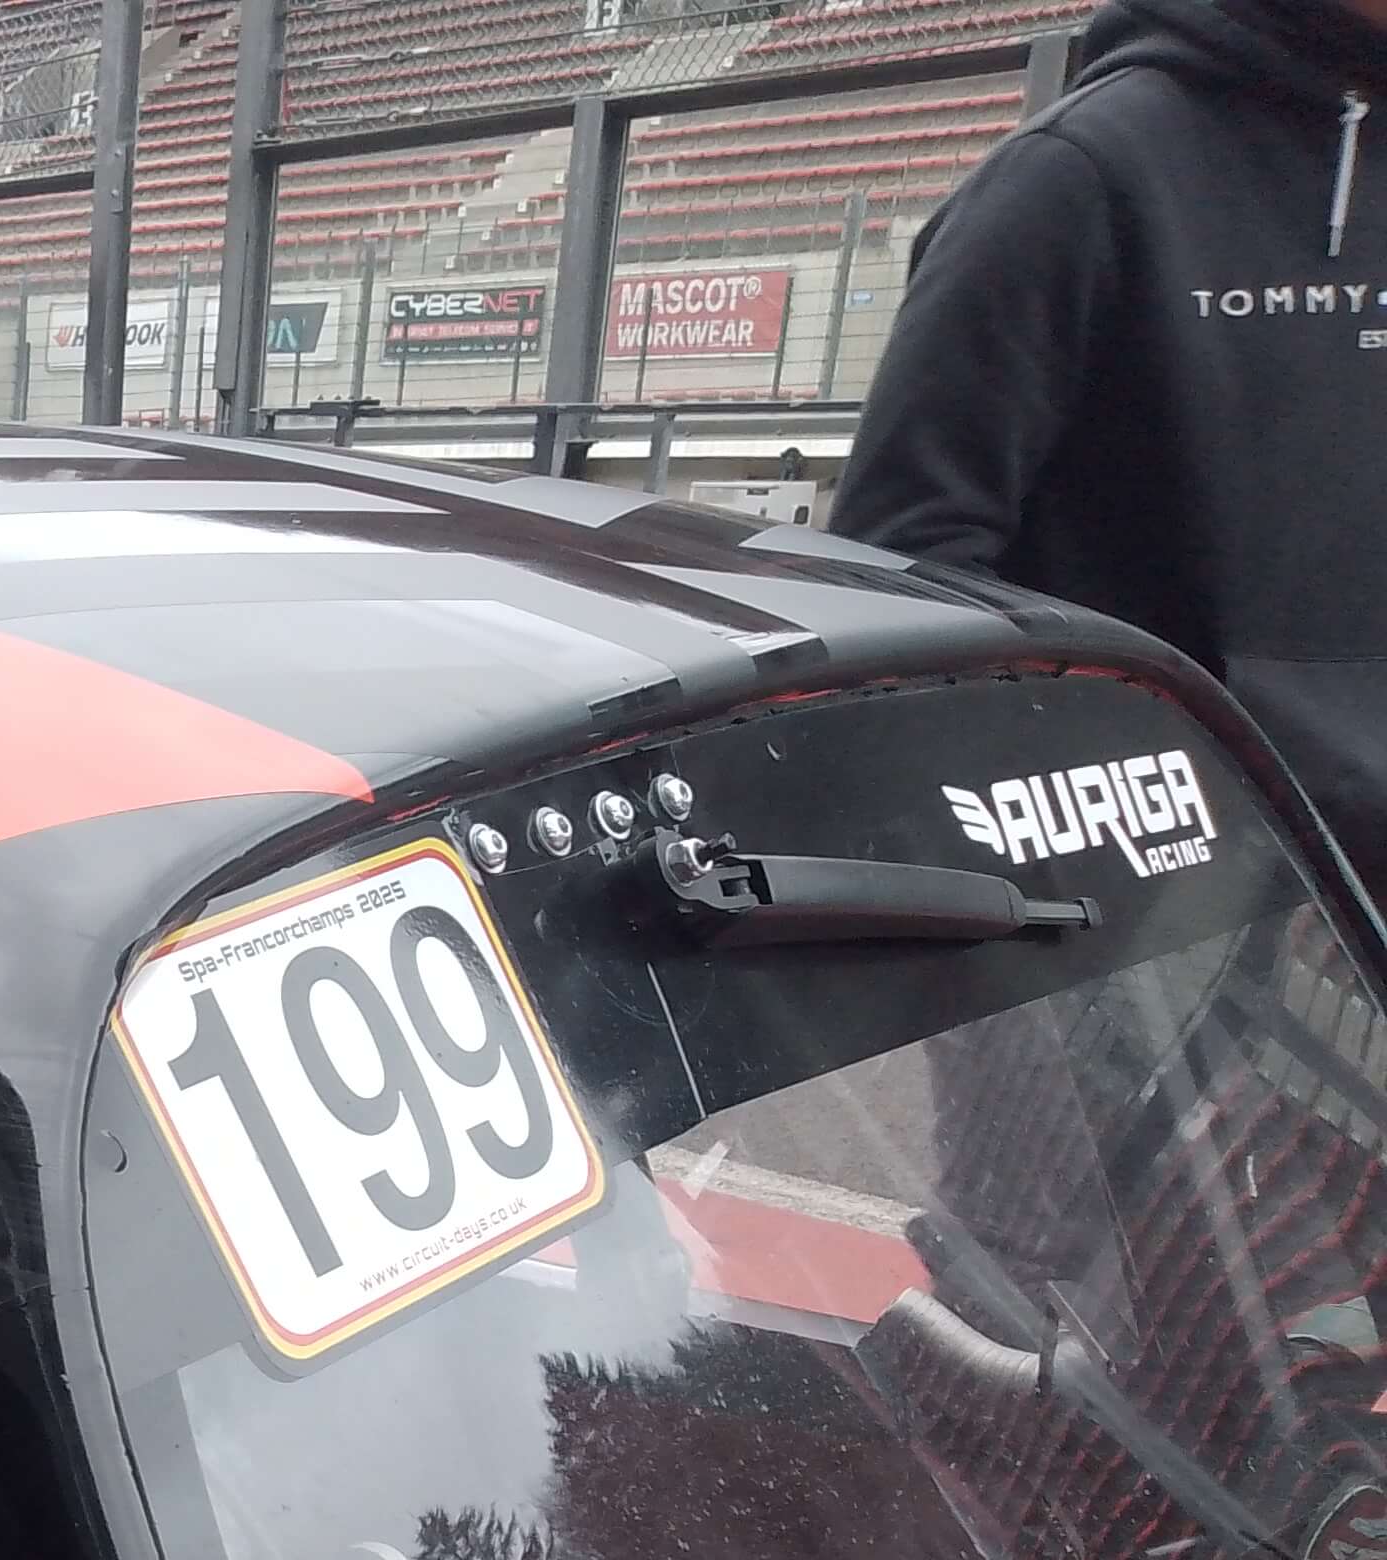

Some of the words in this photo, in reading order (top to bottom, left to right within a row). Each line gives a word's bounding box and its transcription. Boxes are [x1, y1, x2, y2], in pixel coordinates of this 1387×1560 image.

[390, 288, 545, 318] CYBERNET
[1190, 284, 1369, 317] TOMMY
[70, 322, 166, 347] HOOK
[617, 318, 755, 348] WORKWEAR
[178, 902, 355, 983] Spa-Francorchamps
[355, 879, 407, 914] 2025
[167, 905, 554, 1278] 199
